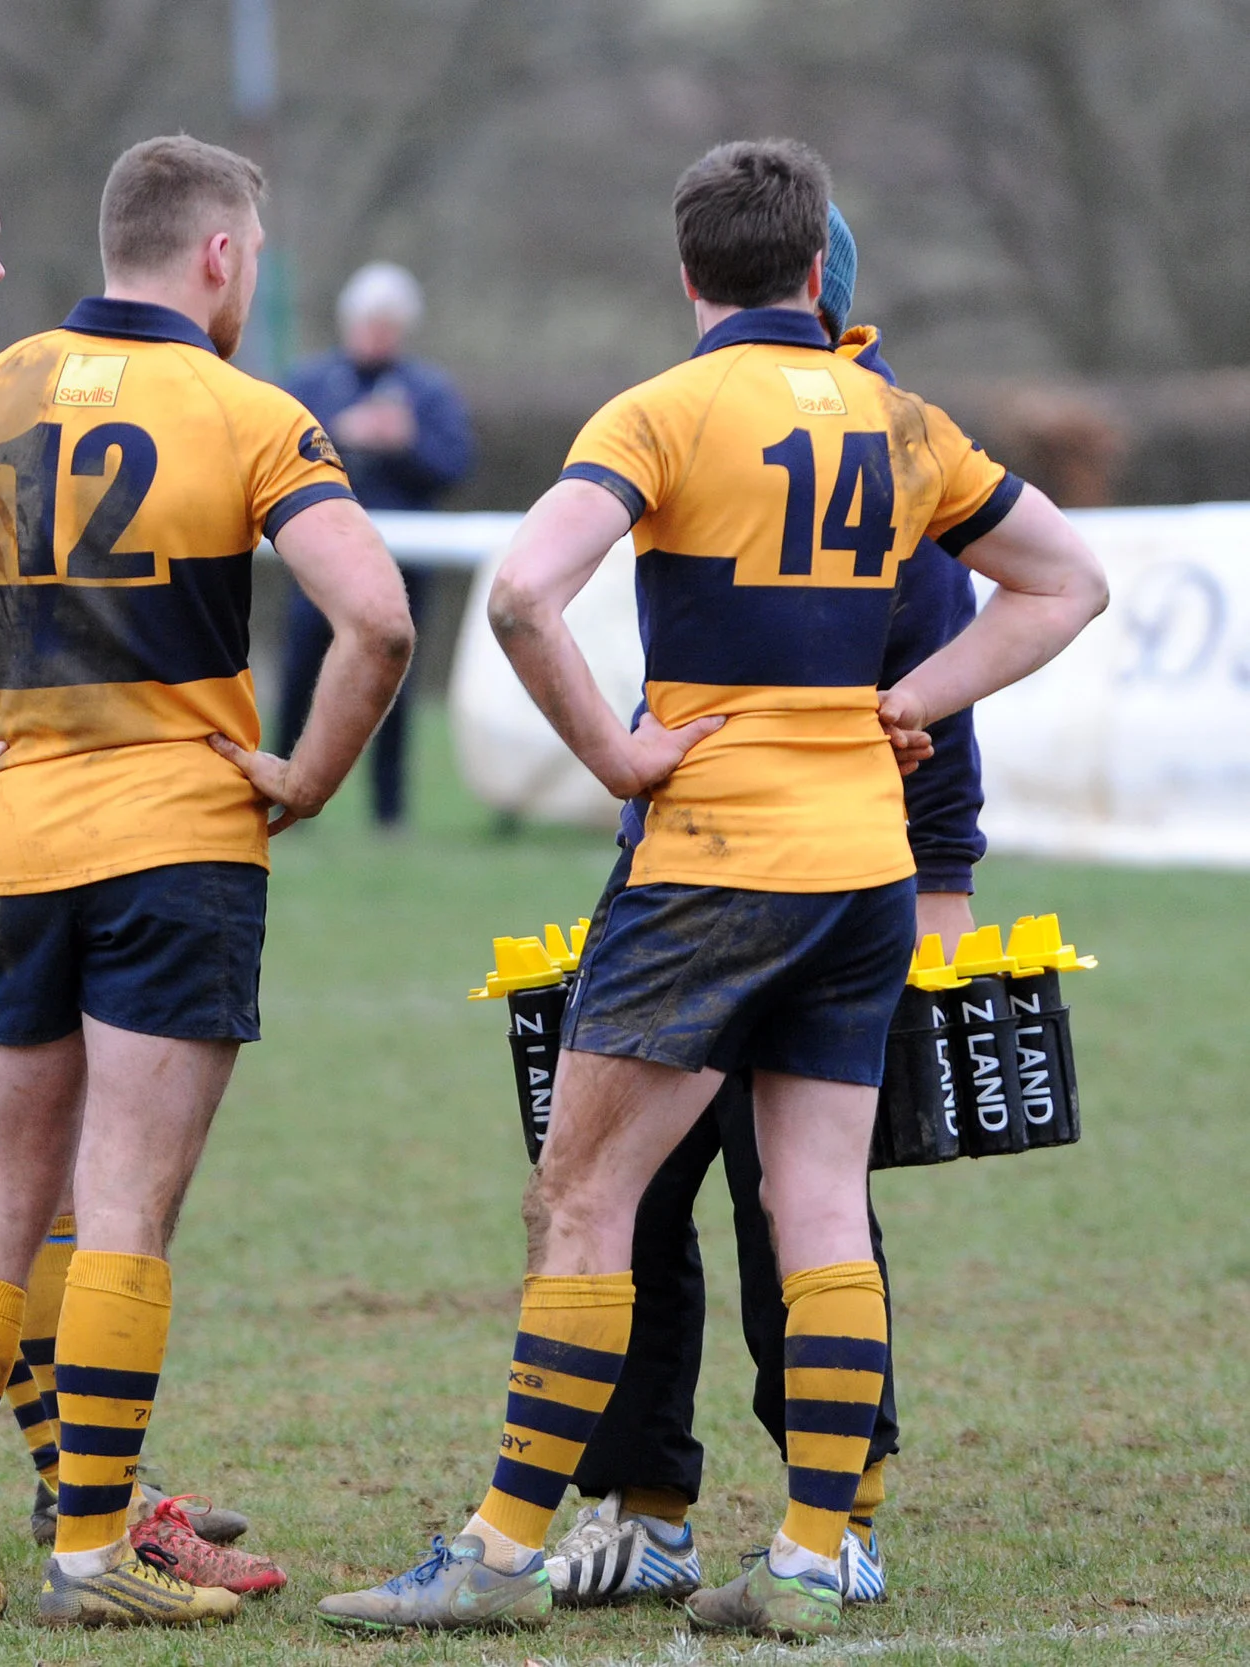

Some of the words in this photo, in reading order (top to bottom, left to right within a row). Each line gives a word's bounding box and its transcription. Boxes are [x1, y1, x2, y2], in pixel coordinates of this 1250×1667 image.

[59, 386, 113, 403] savills
[761, 426, 897, 578] 14
[515, 1013, 544, 1036] Z
[962, 999, 994, 1024] Z
[967, 1033, 1009, 1132] LAND
[1016, 1026, 1054, 1125] LAND
